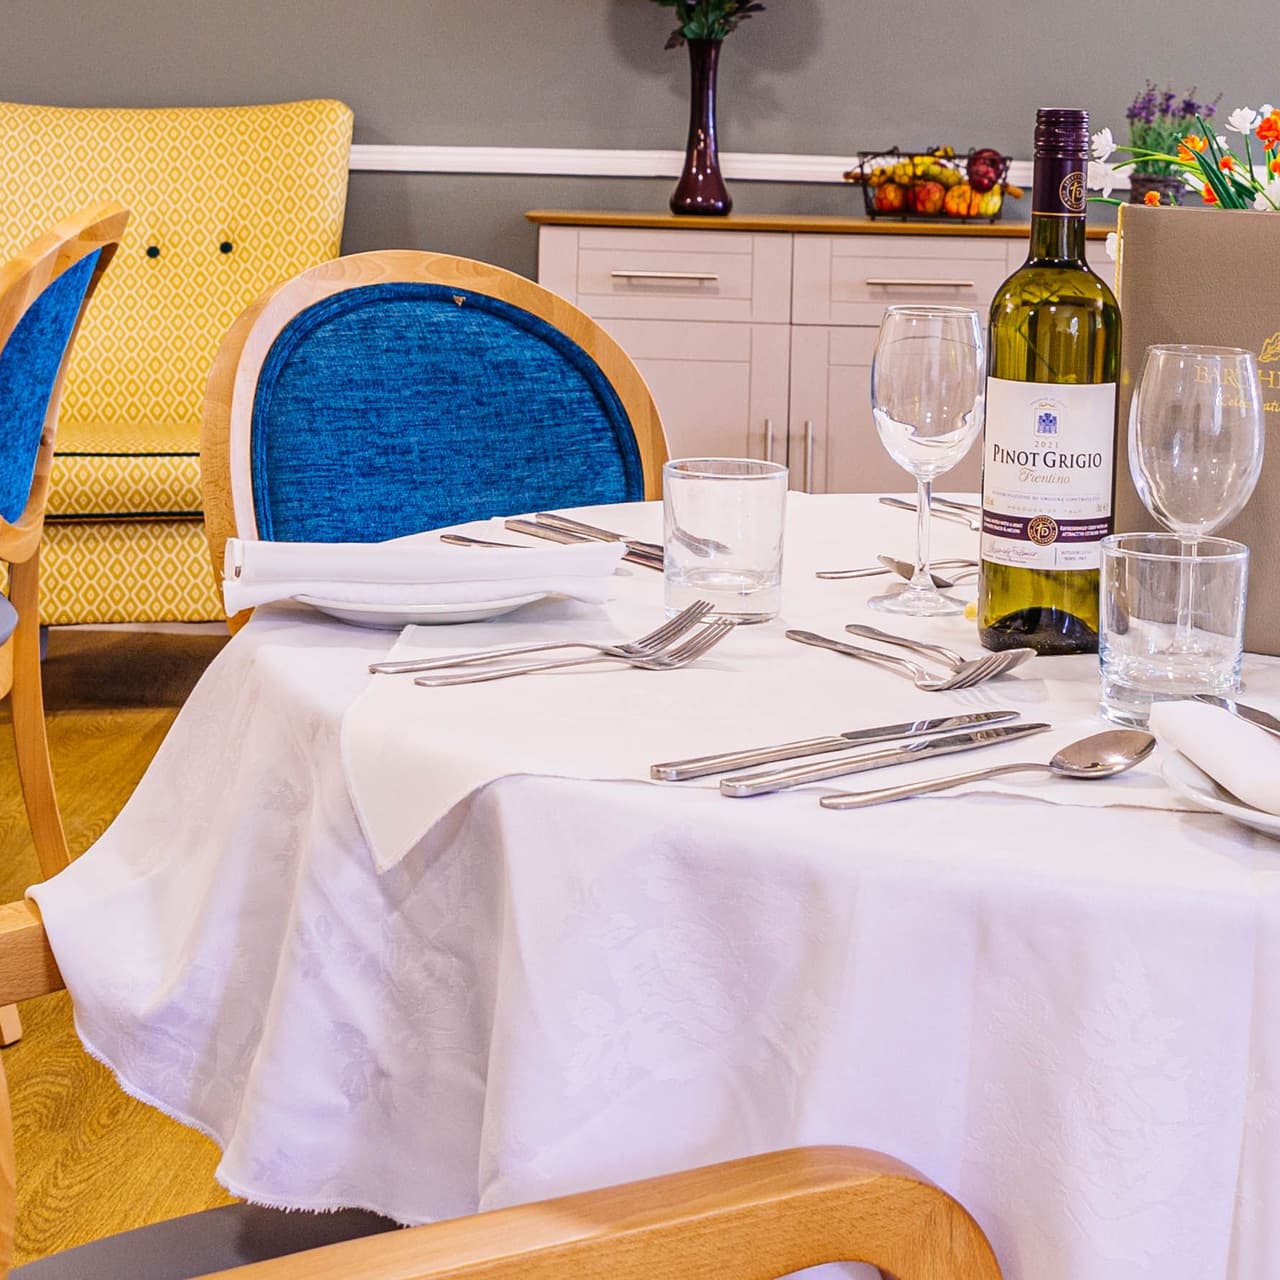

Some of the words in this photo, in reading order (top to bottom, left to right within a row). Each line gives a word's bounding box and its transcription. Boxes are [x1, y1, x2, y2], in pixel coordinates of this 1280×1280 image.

[1033, 440, 1060, 449] 2021
[993, 444, 1040, 468] PINOT
[1043, 451, 1102, 469] GRIGIO
[1019, 467, 1071, 485] Trentino
